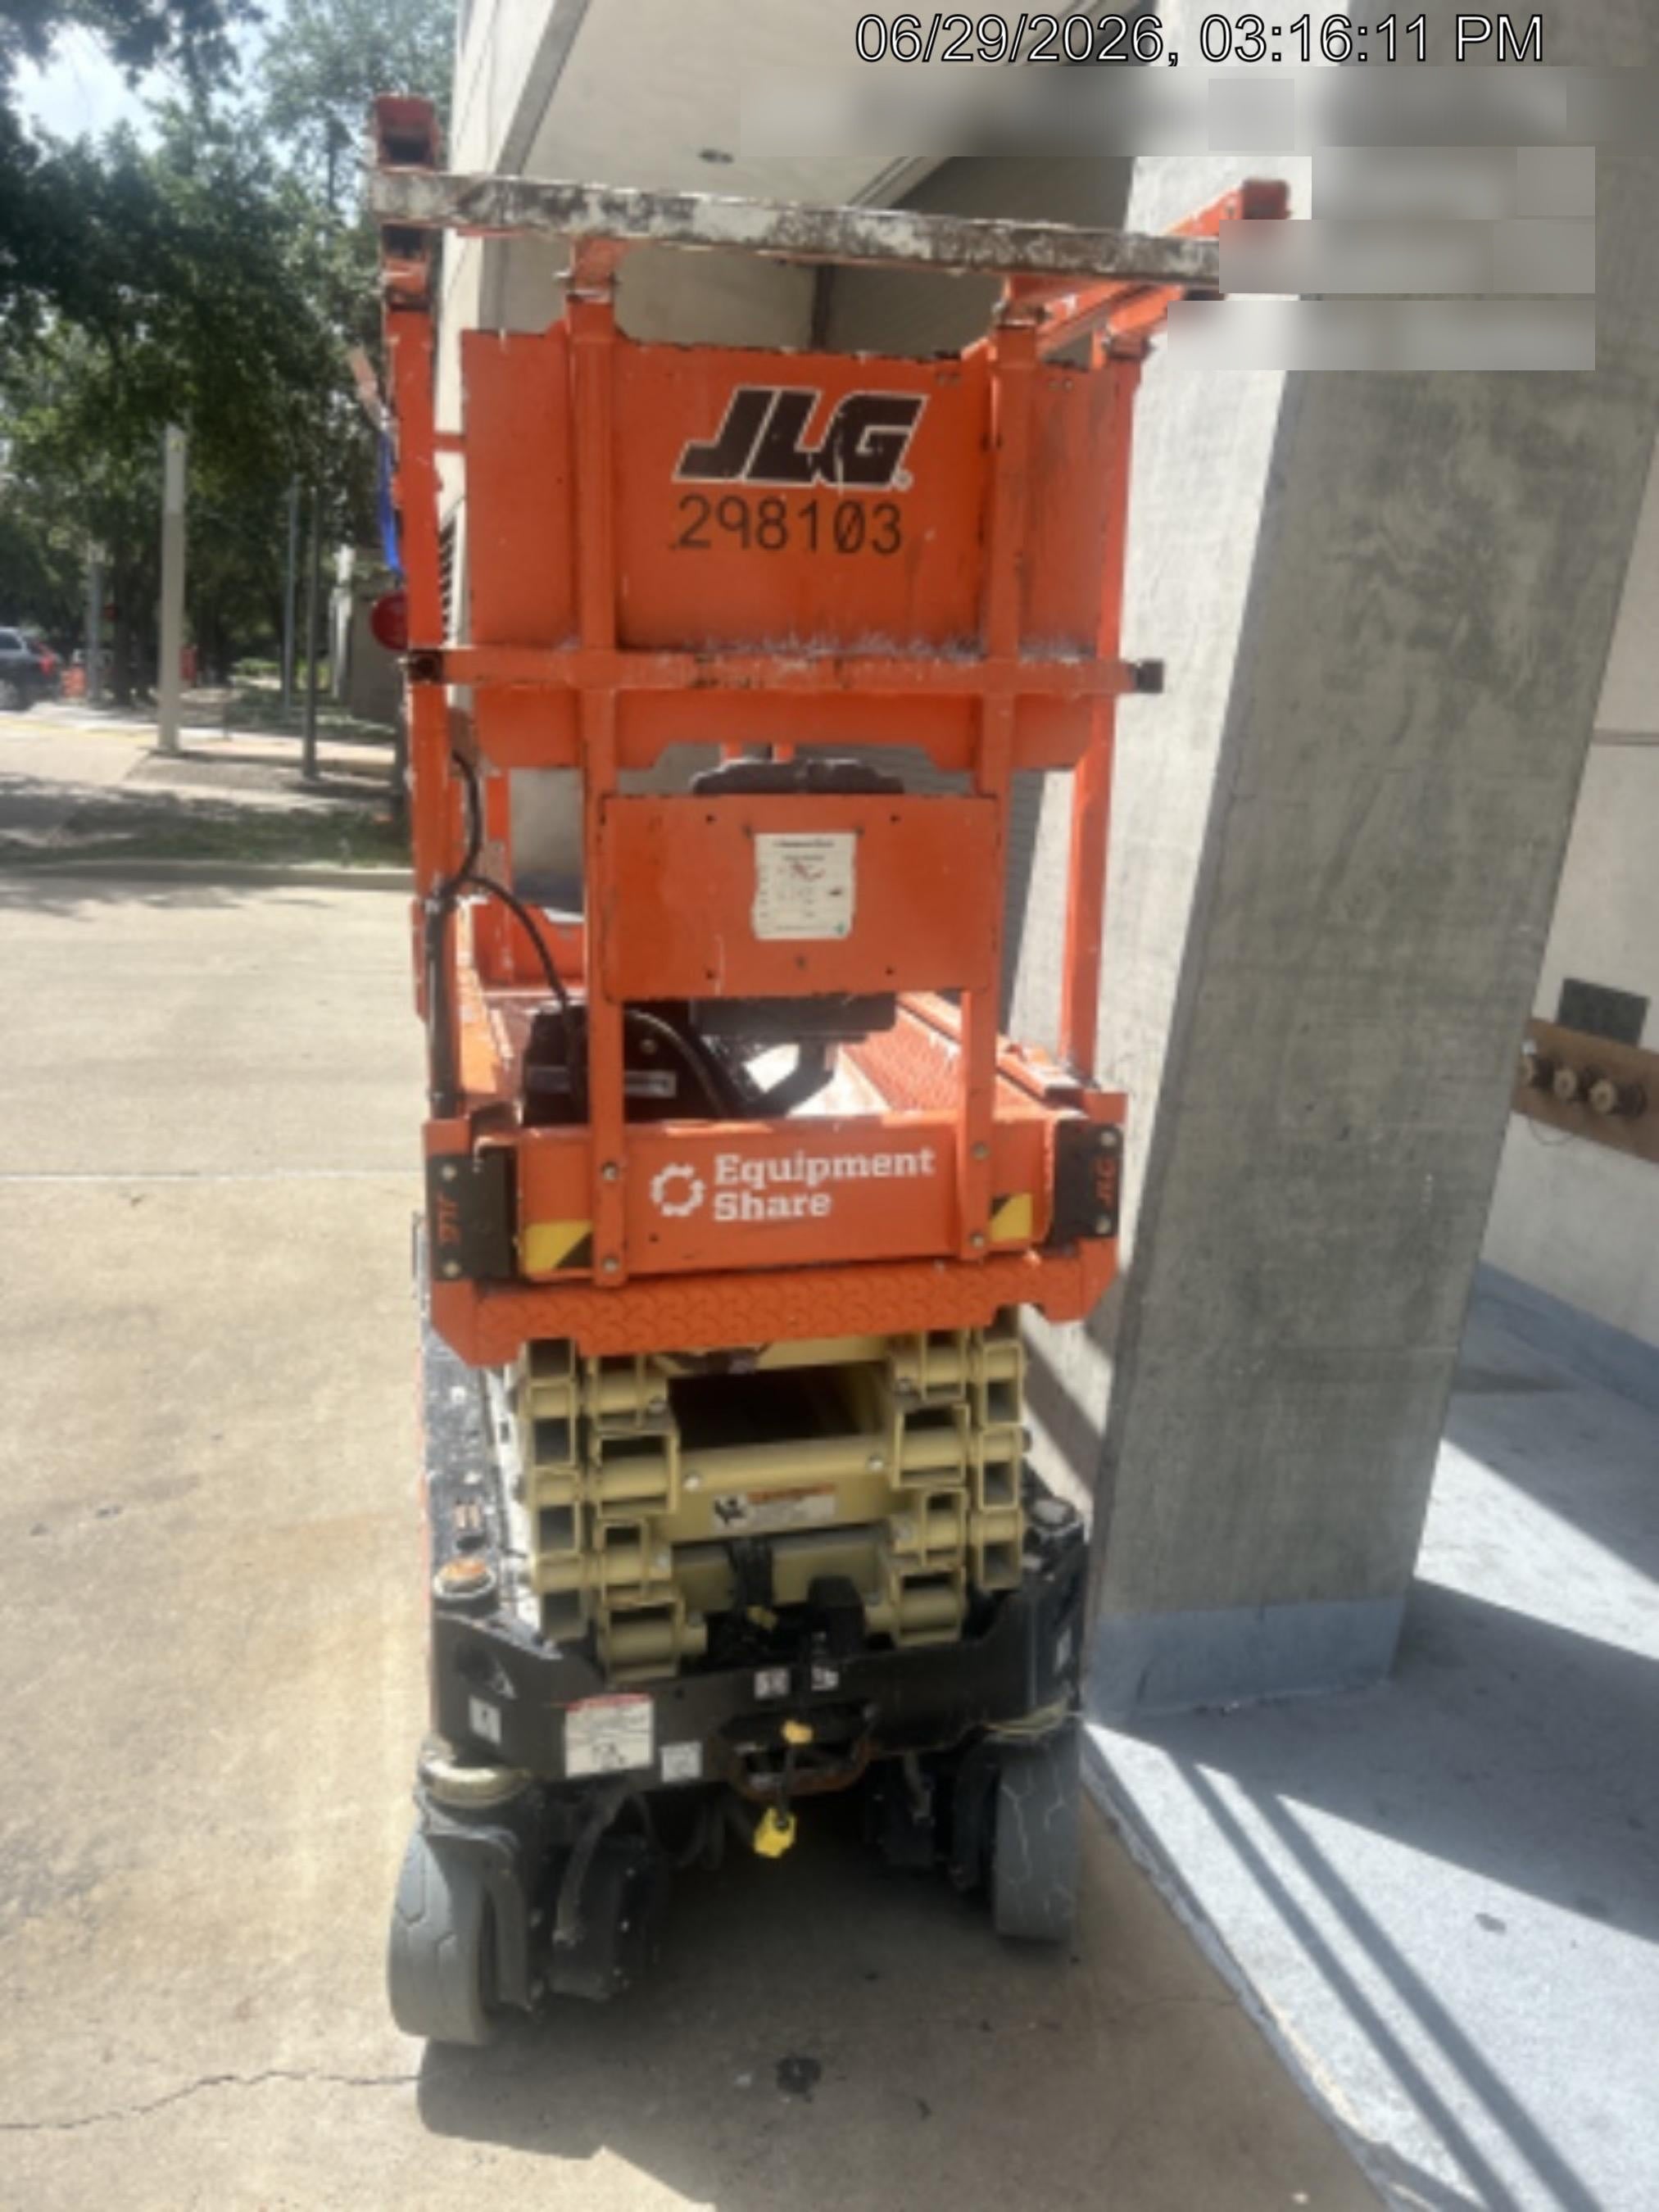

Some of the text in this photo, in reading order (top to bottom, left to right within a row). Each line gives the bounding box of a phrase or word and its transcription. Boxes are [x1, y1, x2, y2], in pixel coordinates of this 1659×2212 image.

[672, 384, 929, 491] JLG
[678, 493, 903, 555] 298103
[714, 1149, 936, 1190] Equipment
[714, 1191, 832, 1222] Share
